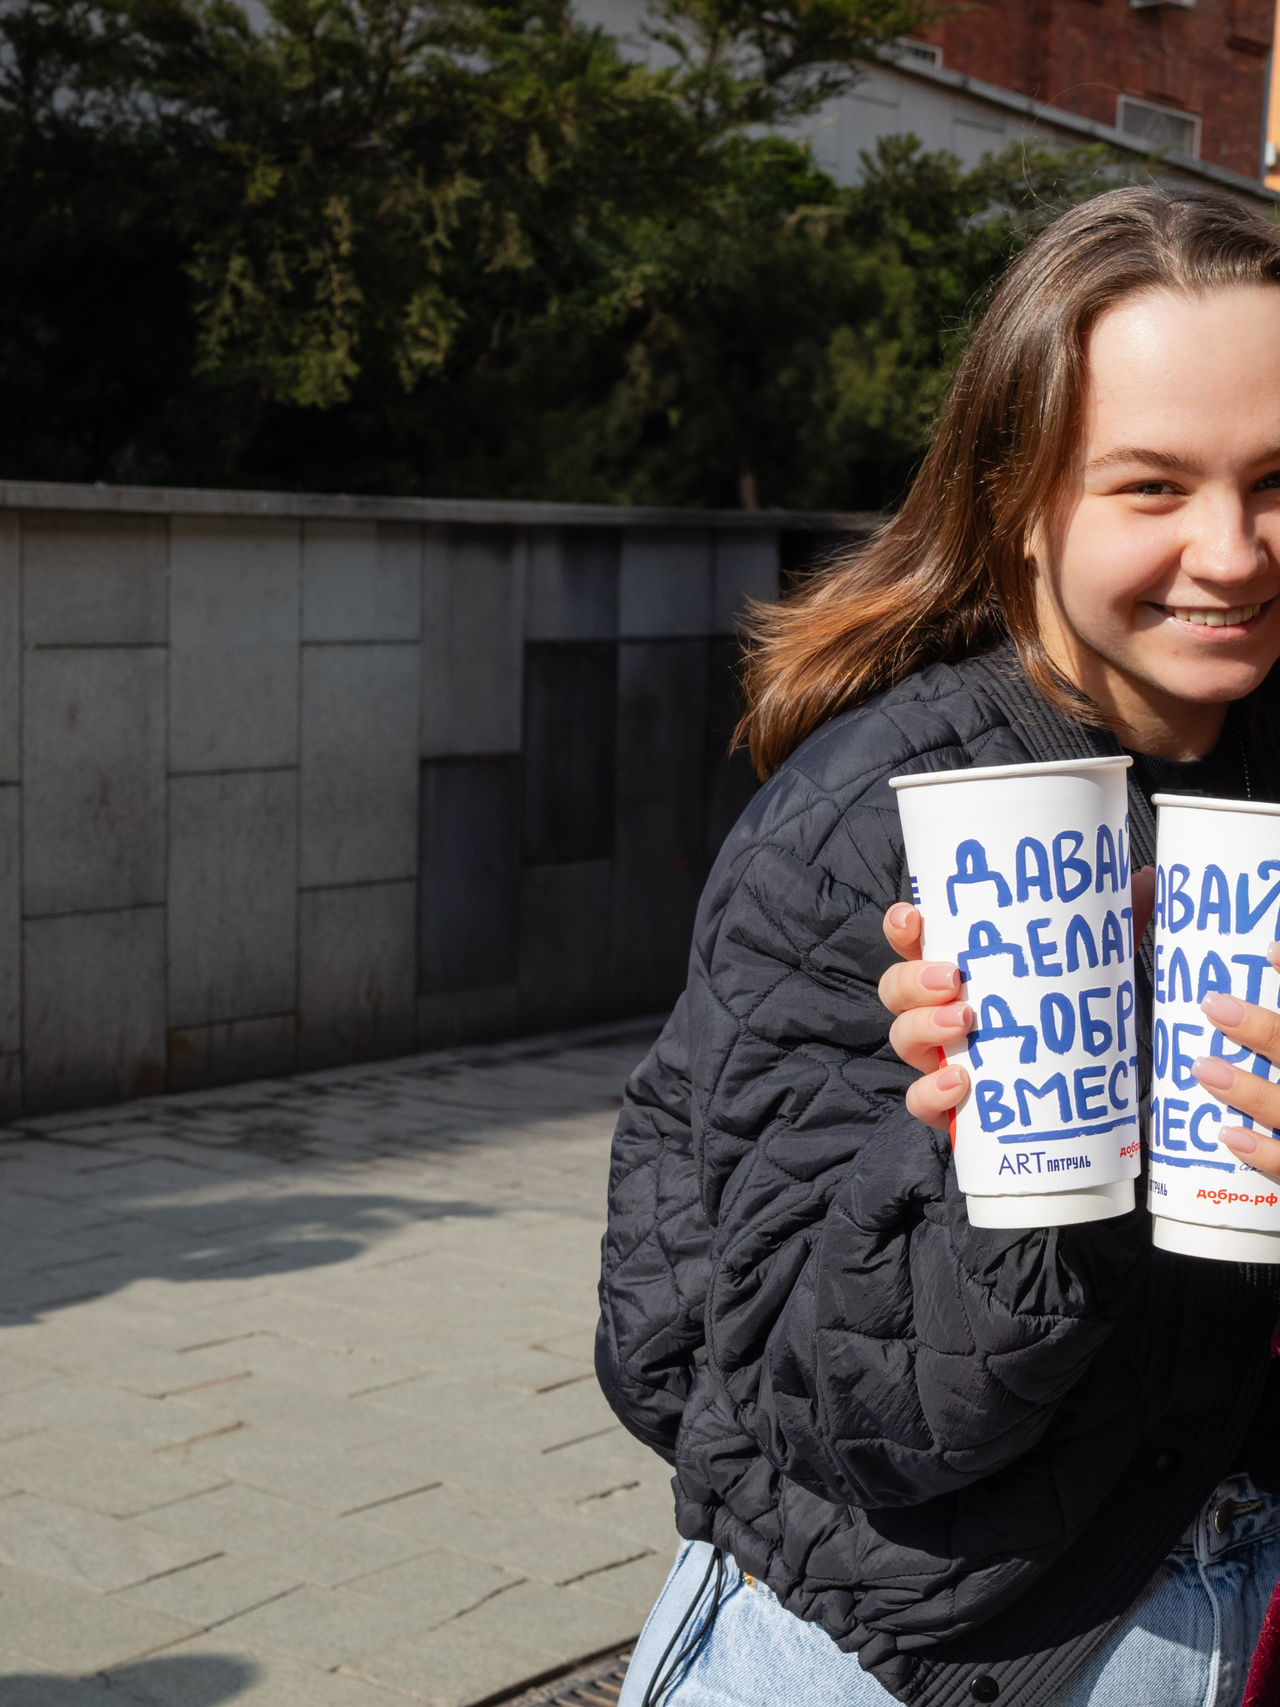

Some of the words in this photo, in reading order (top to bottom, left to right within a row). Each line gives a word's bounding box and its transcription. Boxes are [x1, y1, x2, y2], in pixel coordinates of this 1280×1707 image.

[966, 980, 1138, 1070] ДОБР
[998, 1151, 1046, 1175] ART
[1046, 1155, 1091, 1172] ПАТРУЛЬ
[1196, 1188, 1279, 1207] добро.рф
